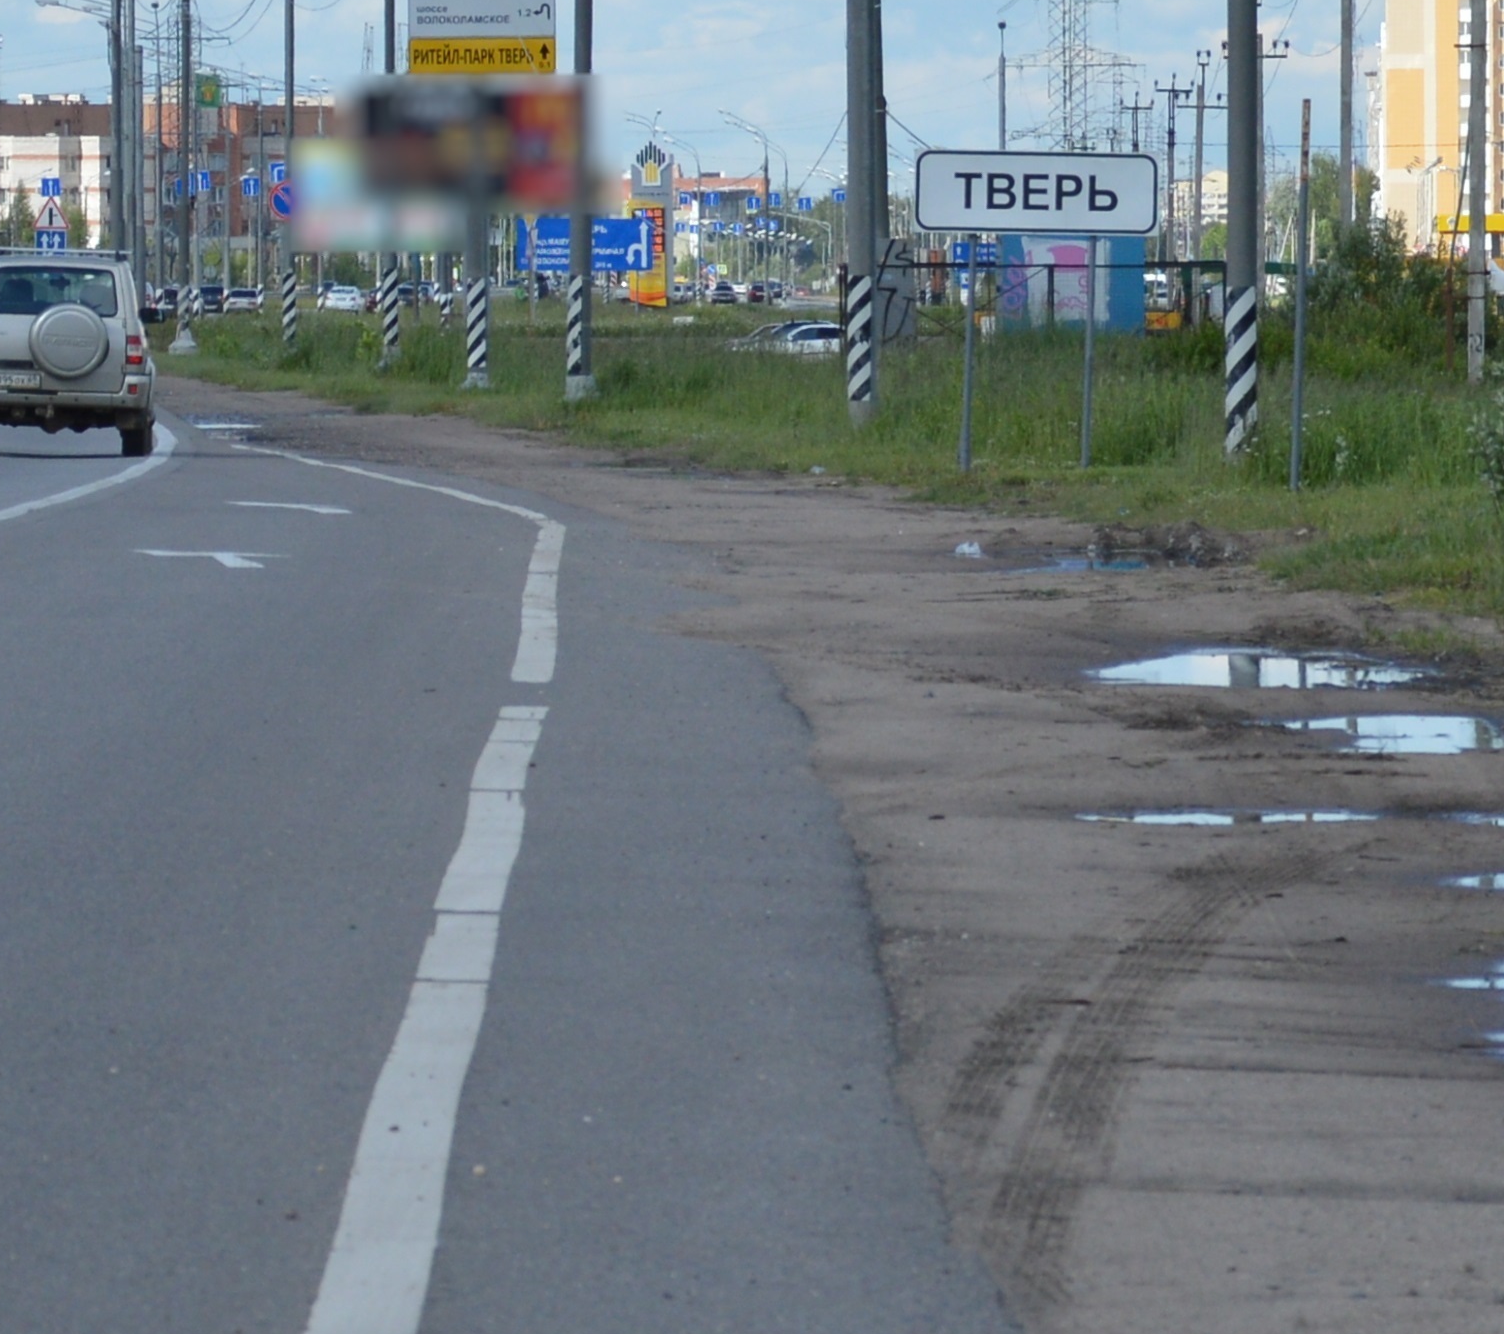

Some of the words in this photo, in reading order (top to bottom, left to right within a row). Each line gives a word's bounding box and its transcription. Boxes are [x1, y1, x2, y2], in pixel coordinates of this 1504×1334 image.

[416, 5, 448, 13] шоссе
[416, 14, 511, 25] ВОЛОКОЛАМСКОЕ
[413, 43, 496, 65] РИТЕЙЛ-ПАРК
[498, 47, 535, 65] ТВЕРЬ
[954, 171, 1119, 212] ТВЕРЬ
